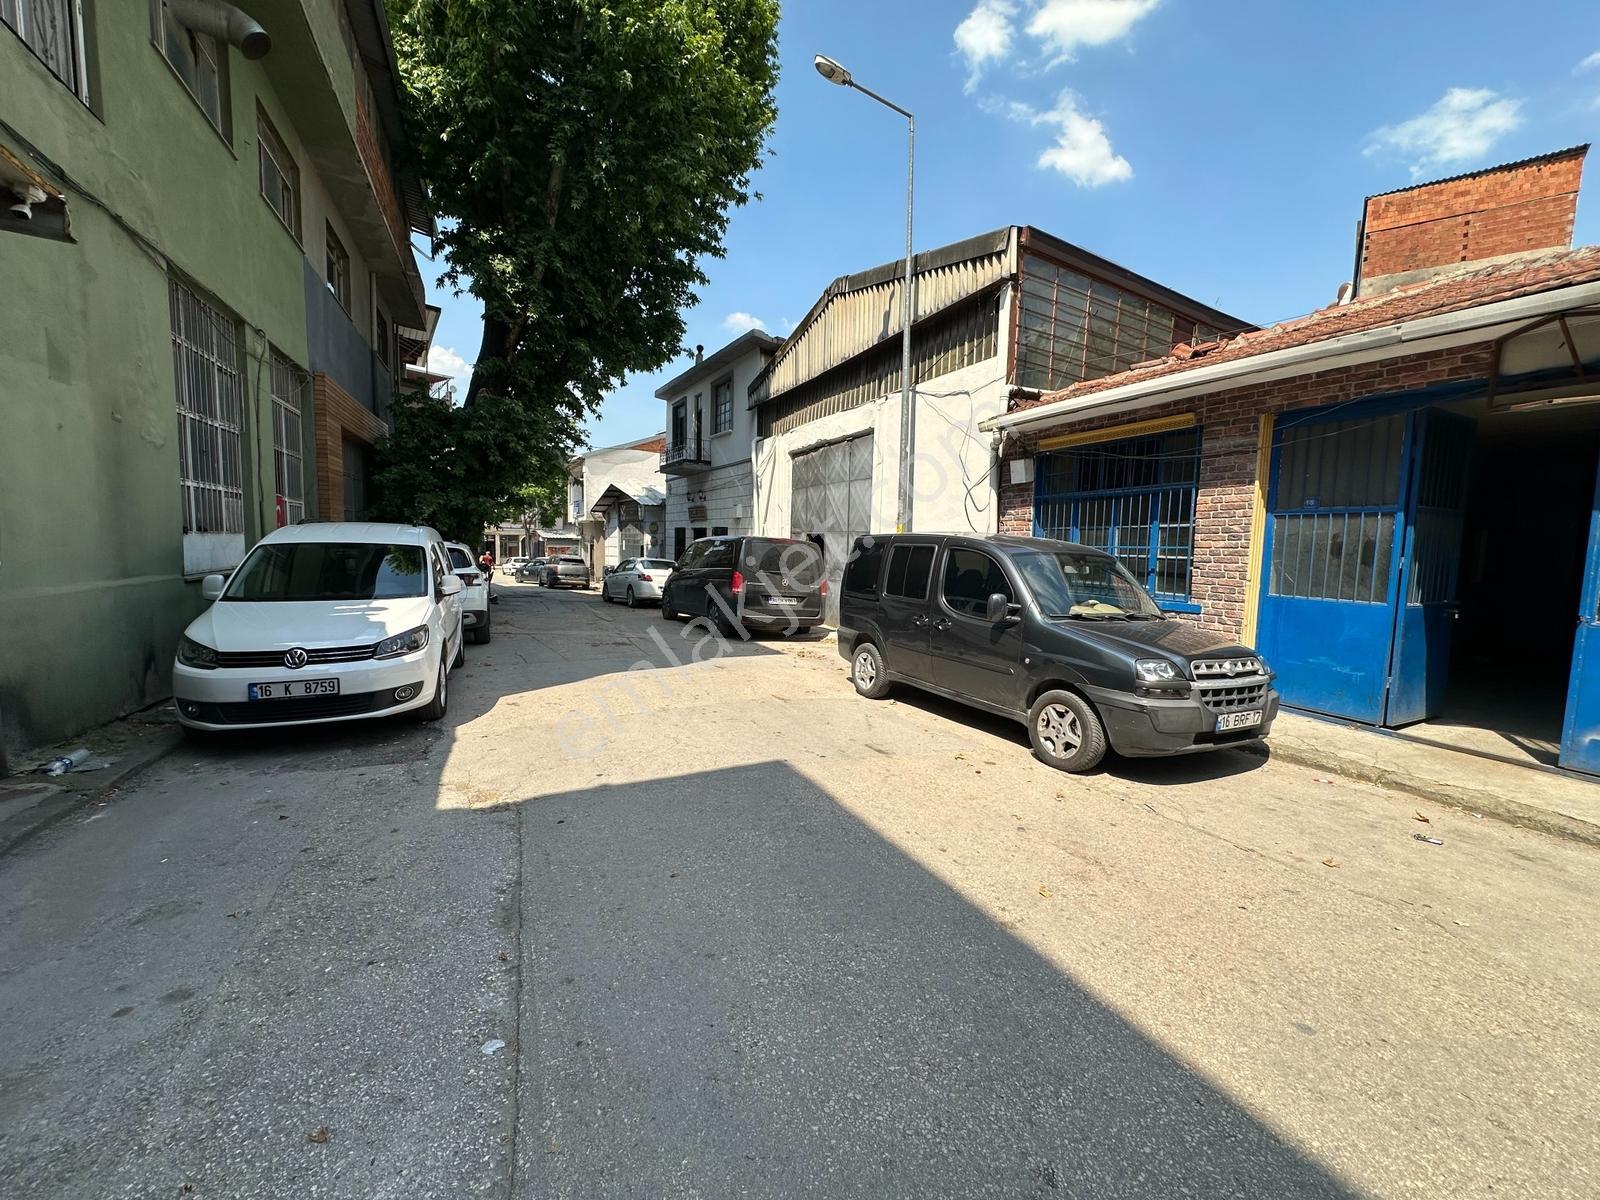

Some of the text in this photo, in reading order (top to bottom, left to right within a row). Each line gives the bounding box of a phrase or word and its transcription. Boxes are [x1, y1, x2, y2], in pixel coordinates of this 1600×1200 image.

[259, 681, 336, 697] 16 K 8759
[1221, 715, 1230, 728] 16
[1233, 713, 1251, 727] BRF
